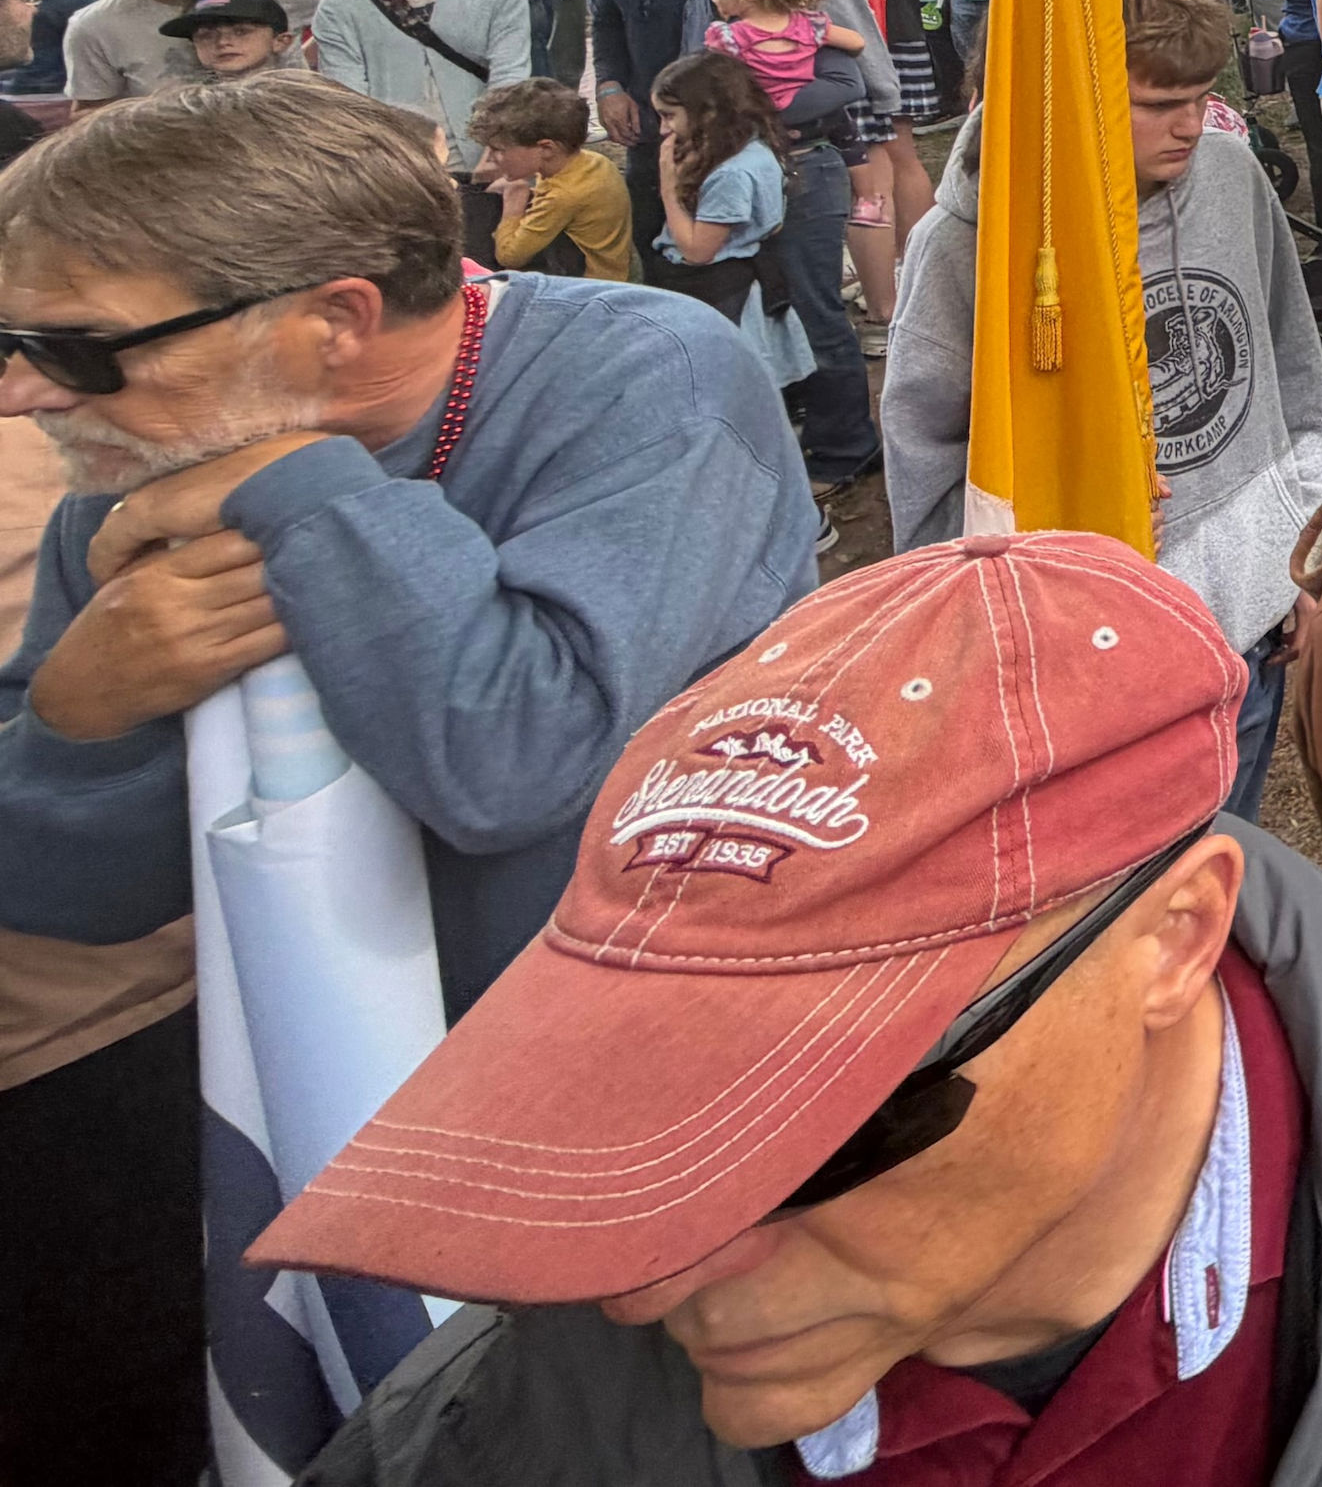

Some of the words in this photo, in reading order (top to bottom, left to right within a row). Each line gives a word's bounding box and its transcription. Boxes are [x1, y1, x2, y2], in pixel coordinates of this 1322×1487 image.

[1200, 286, 1219, 304] OF
[1217, 296, 1250, 369] ARLINGTON
[688, 697, 819, 738] NATIONAL
[818, 713, 879, 769] PARK
[612, 759, 870, 831] Shenandoah
[648, 832, 698, 857] EST
[706, 839, 773, 867] 1935
